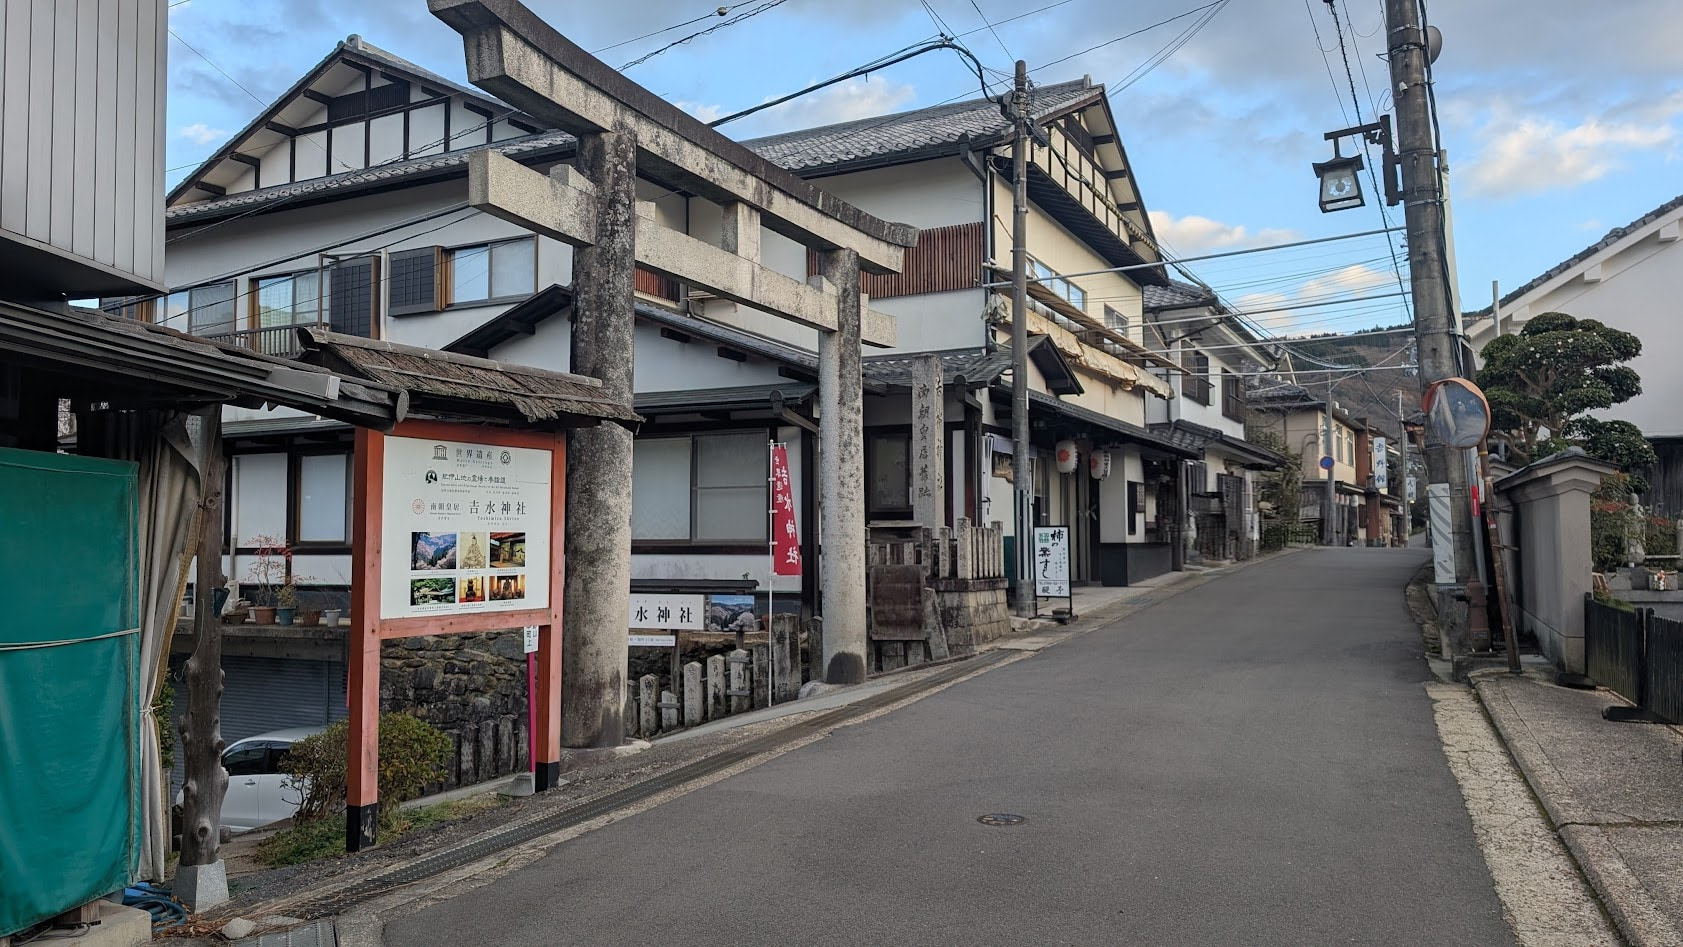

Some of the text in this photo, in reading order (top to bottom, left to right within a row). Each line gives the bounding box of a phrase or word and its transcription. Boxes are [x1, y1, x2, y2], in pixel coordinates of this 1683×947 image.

[456, 447, 493, 460] 世界遺産
[430, 499, 526, 515] 南朝皇居 吉水神社
[1050, 528, 1065, 548] 柿の
[1038, 546, 1051, 580] 葉すし
[634, 605, 694, 623] 水神社
